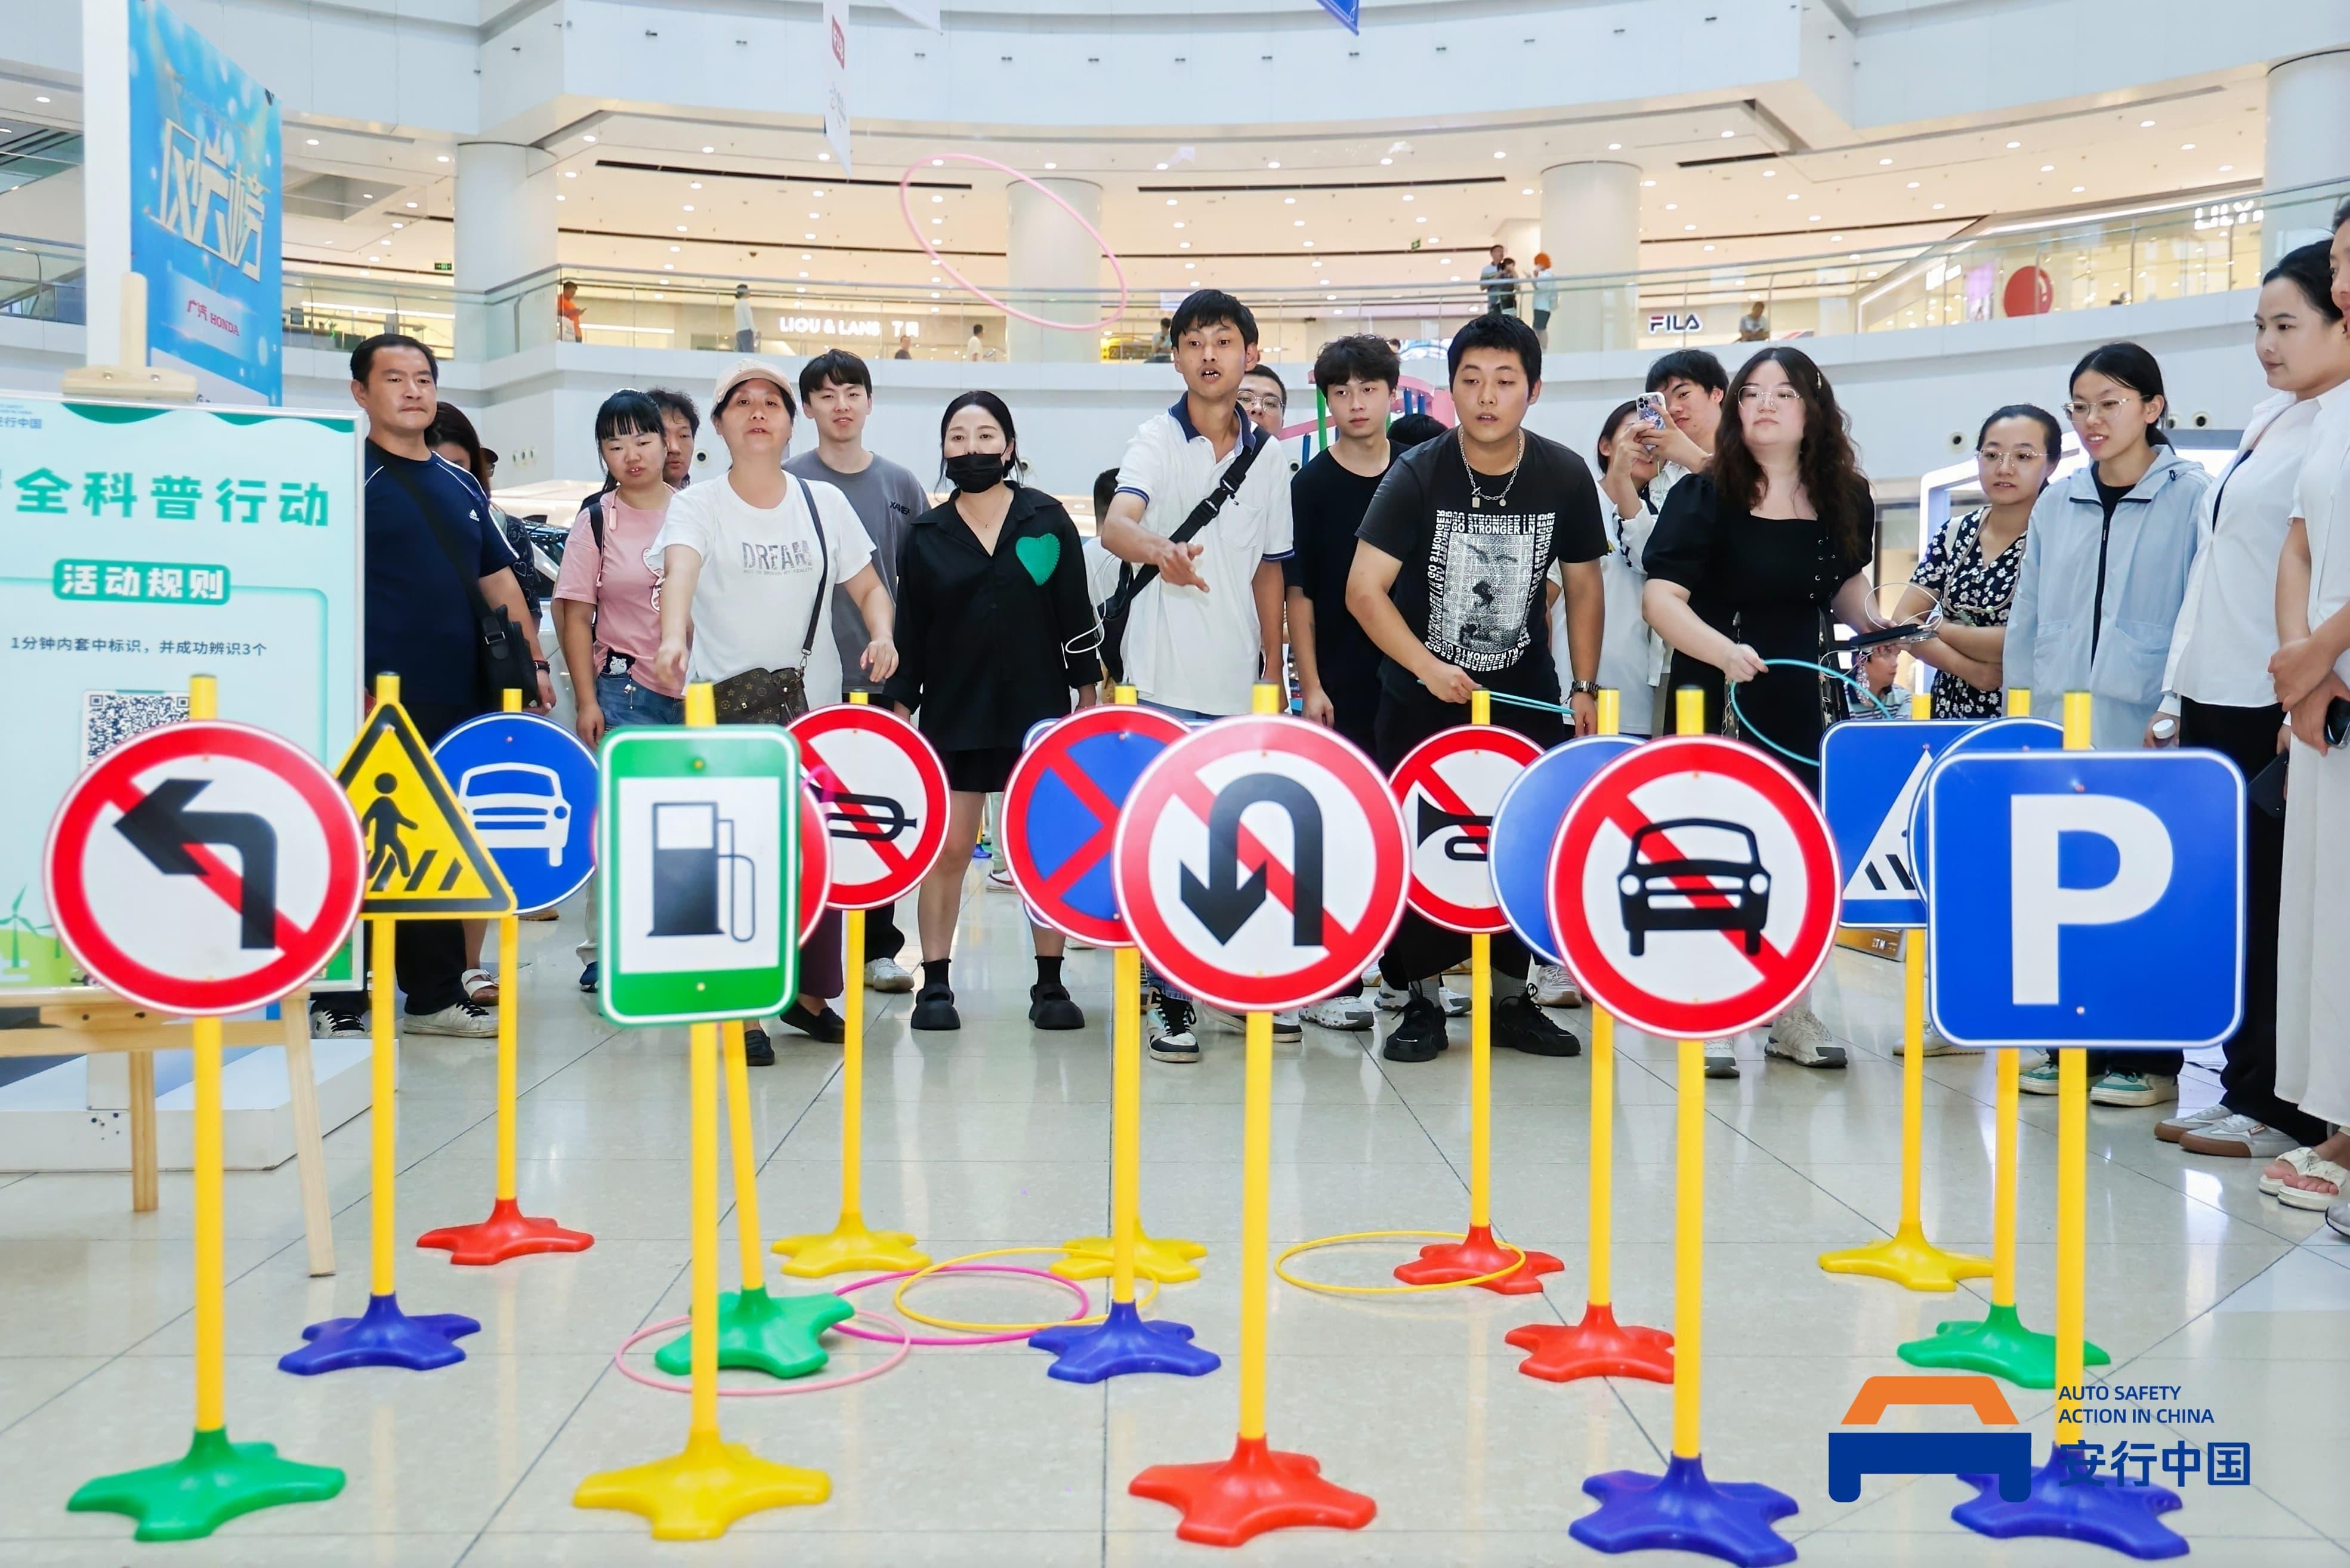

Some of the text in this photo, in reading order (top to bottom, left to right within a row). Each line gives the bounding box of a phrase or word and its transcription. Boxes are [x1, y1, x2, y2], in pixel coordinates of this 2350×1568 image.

[187, 300, 240, 337] 广汽 HONDA
[1650, 314, 1700, 332] FILA
[0, 467, 329, 526] 全科普行动
[1452, 523, 1465, 532] GO
[1468, 524, 1521, 535] STRONGER
[62, 564, 224, 600] 活动规则
[2011, 794, 2173, 1005] P
